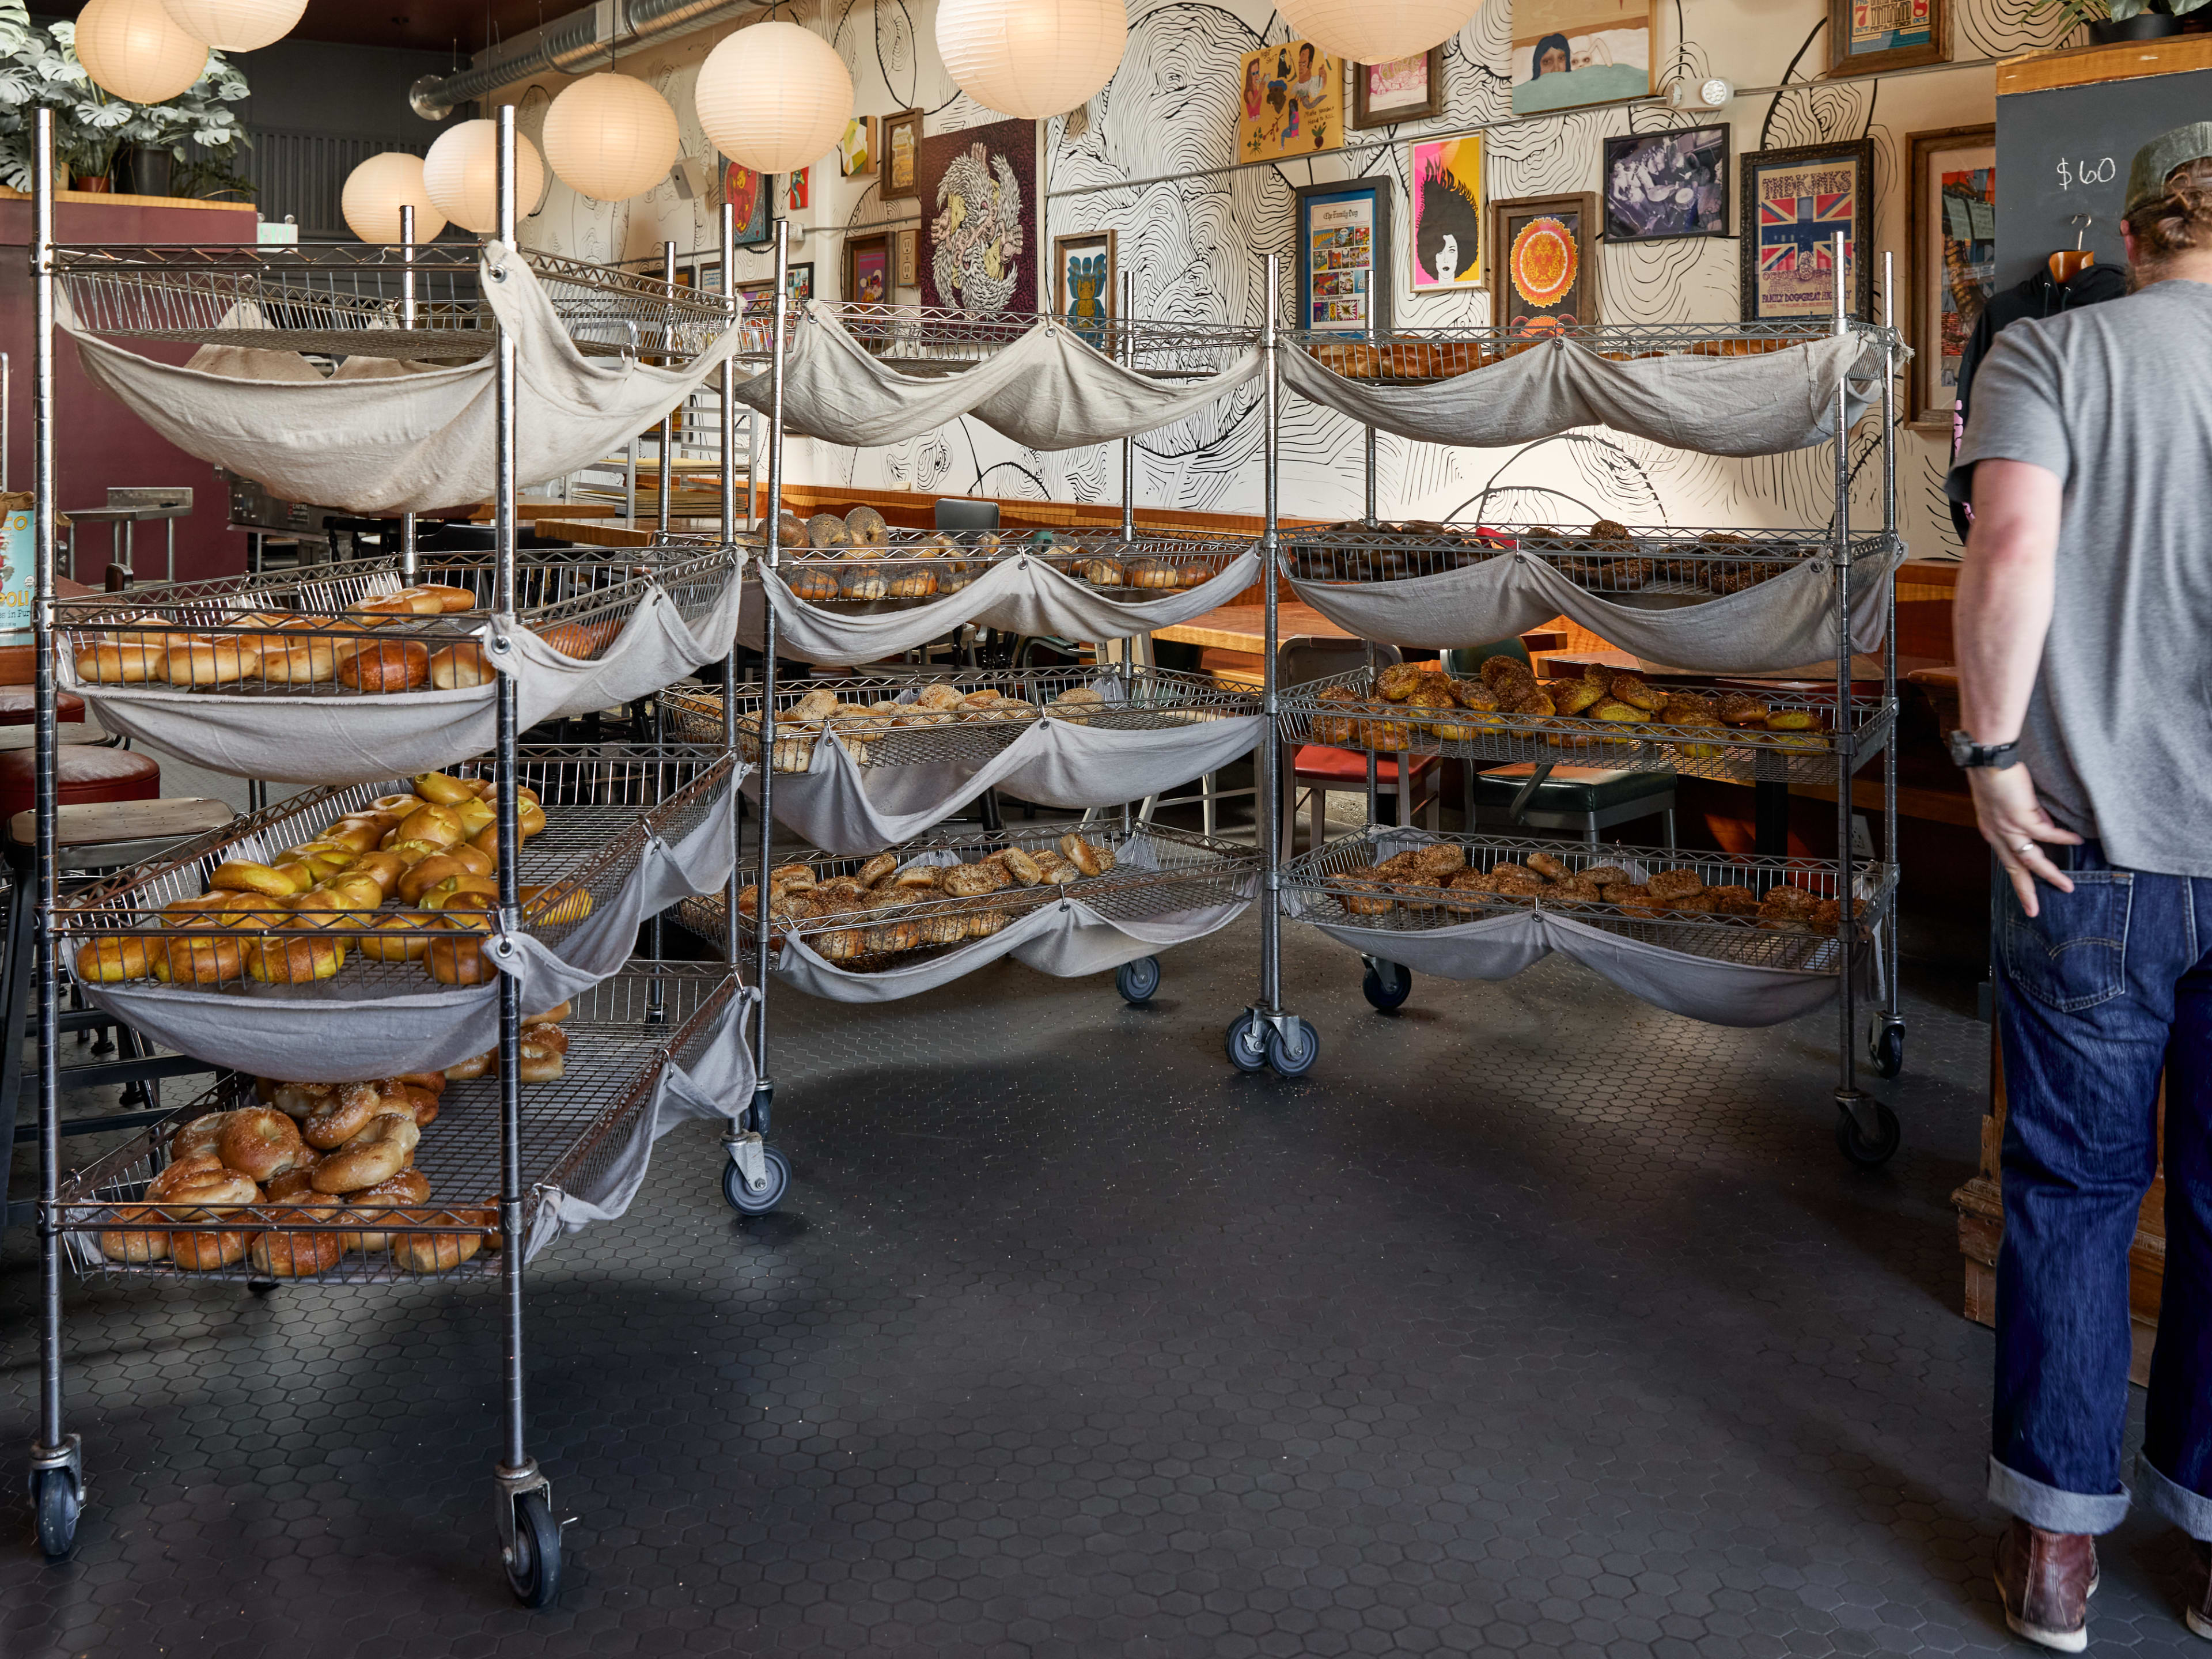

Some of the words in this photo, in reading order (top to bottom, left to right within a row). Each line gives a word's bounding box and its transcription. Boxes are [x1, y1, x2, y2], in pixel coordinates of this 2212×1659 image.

[1855, 5, 1869, 26] 7
[1913, 0, 1927, 17] 8
[2056, 157, 2116, 191] $60
[1762, 175, 1794, 200] THE
[1796, 170, 1851, 197] KINKS
[259, 224, 291, 245] EXIT
[1762, 294, 1784, 303] FAMILY
